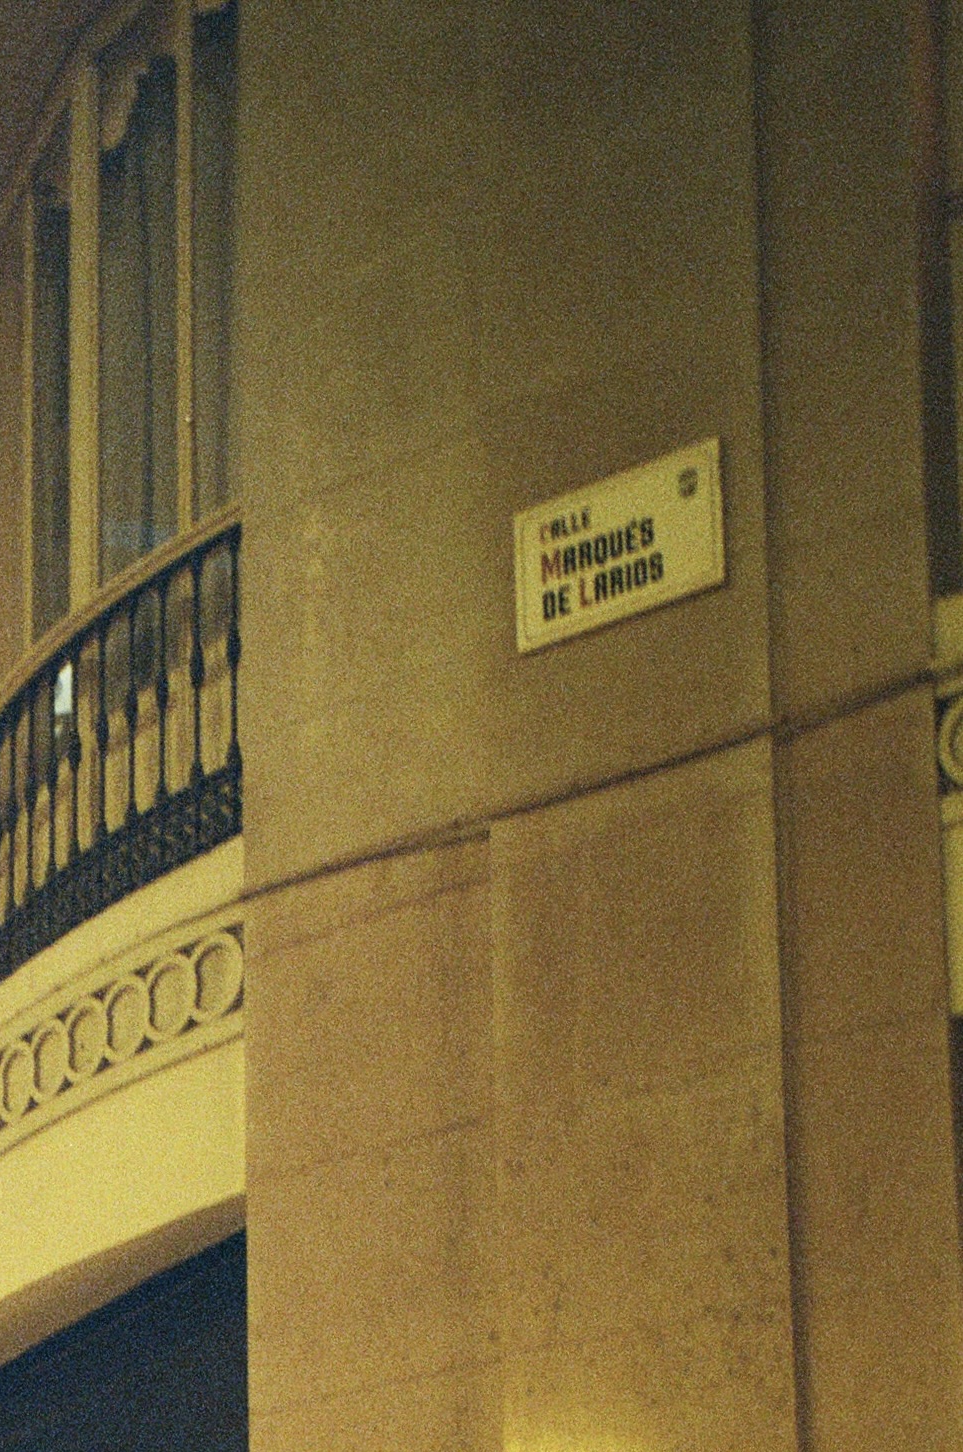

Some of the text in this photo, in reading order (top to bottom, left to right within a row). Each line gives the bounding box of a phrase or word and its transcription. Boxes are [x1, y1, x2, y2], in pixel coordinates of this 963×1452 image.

[540, 508, 591, 544] CALLE
[541, 516, 654, 584] MARQUÉS
[542, 550, 664, 621] DE LARIOS
